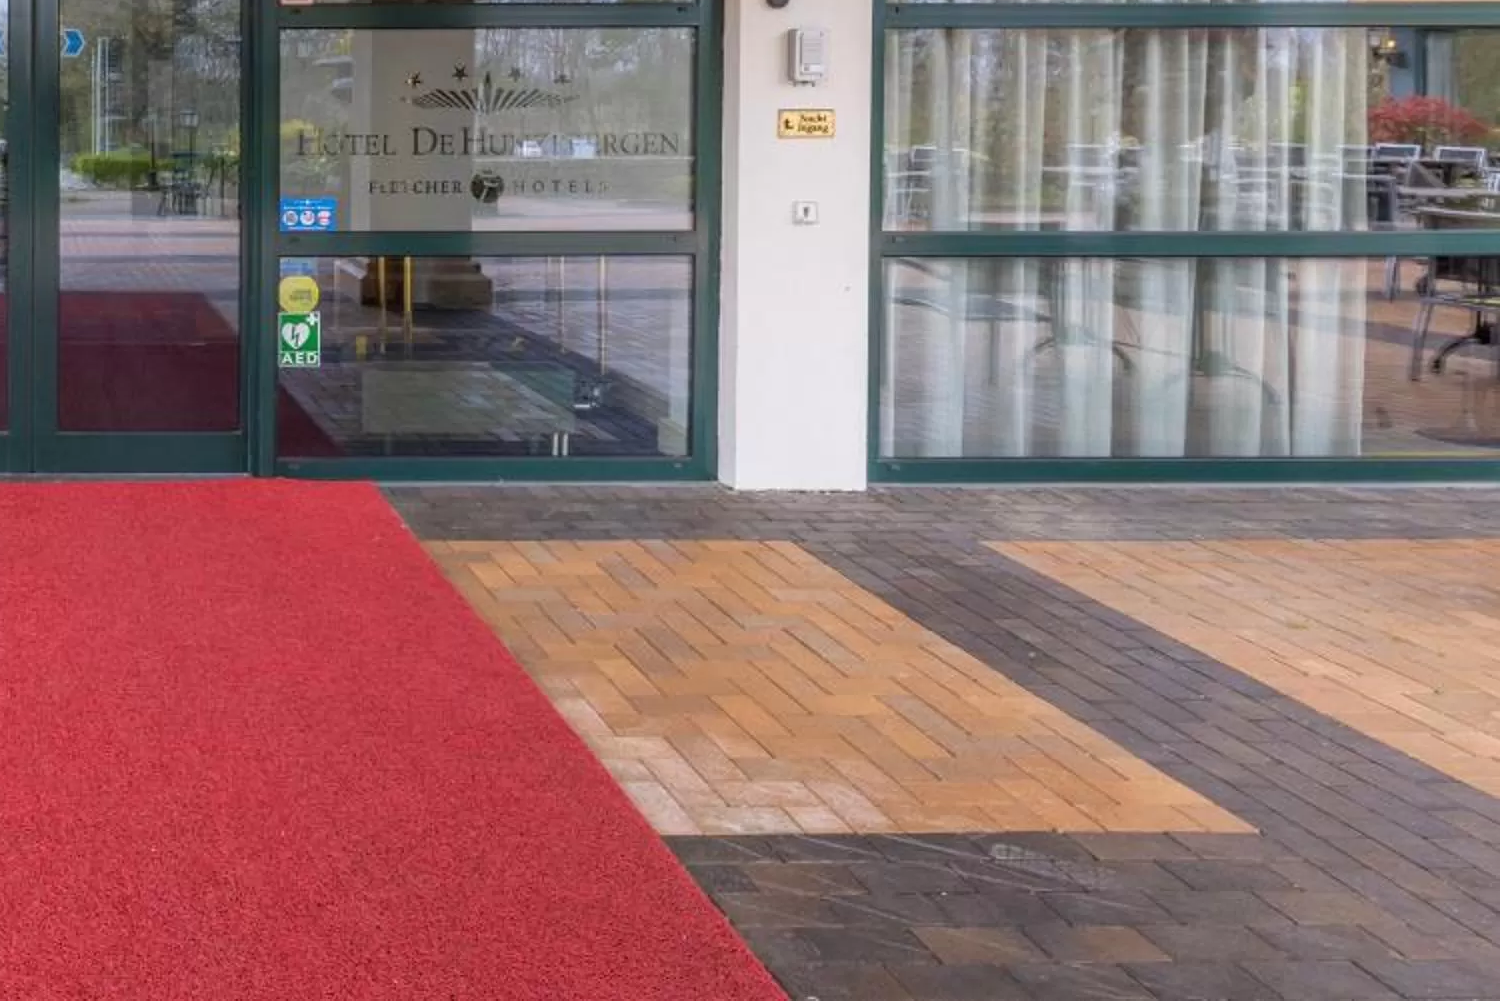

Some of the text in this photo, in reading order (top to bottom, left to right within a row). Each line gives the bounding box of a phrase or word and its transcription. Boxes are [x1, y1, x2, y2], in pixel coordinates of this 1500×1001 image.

[295, 126, 397, 157] HOTEL
[368, 179, 463, 195] FLETCHER
[281, 352, 318, 365] AED
